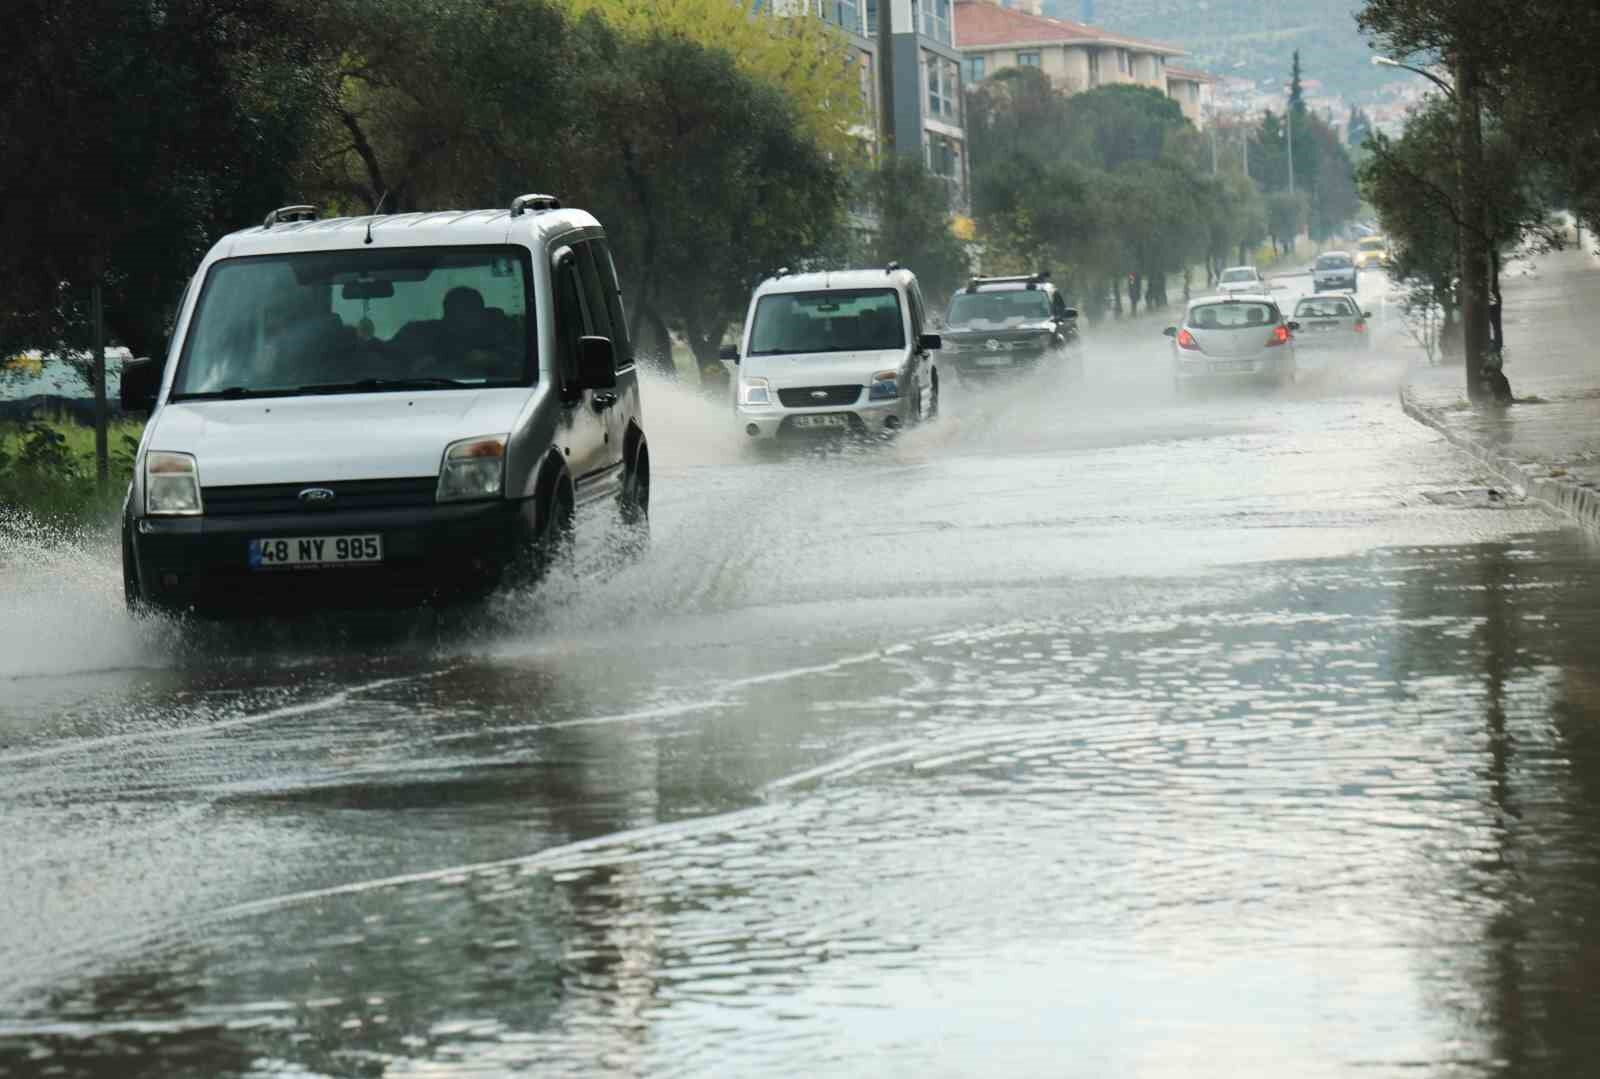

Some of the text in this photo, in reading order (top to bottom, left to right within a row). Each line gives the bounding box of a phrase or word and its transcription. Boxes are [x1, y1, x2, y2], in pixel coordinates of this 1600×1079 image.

[262, 538, 378, 562] 48 NY 985
